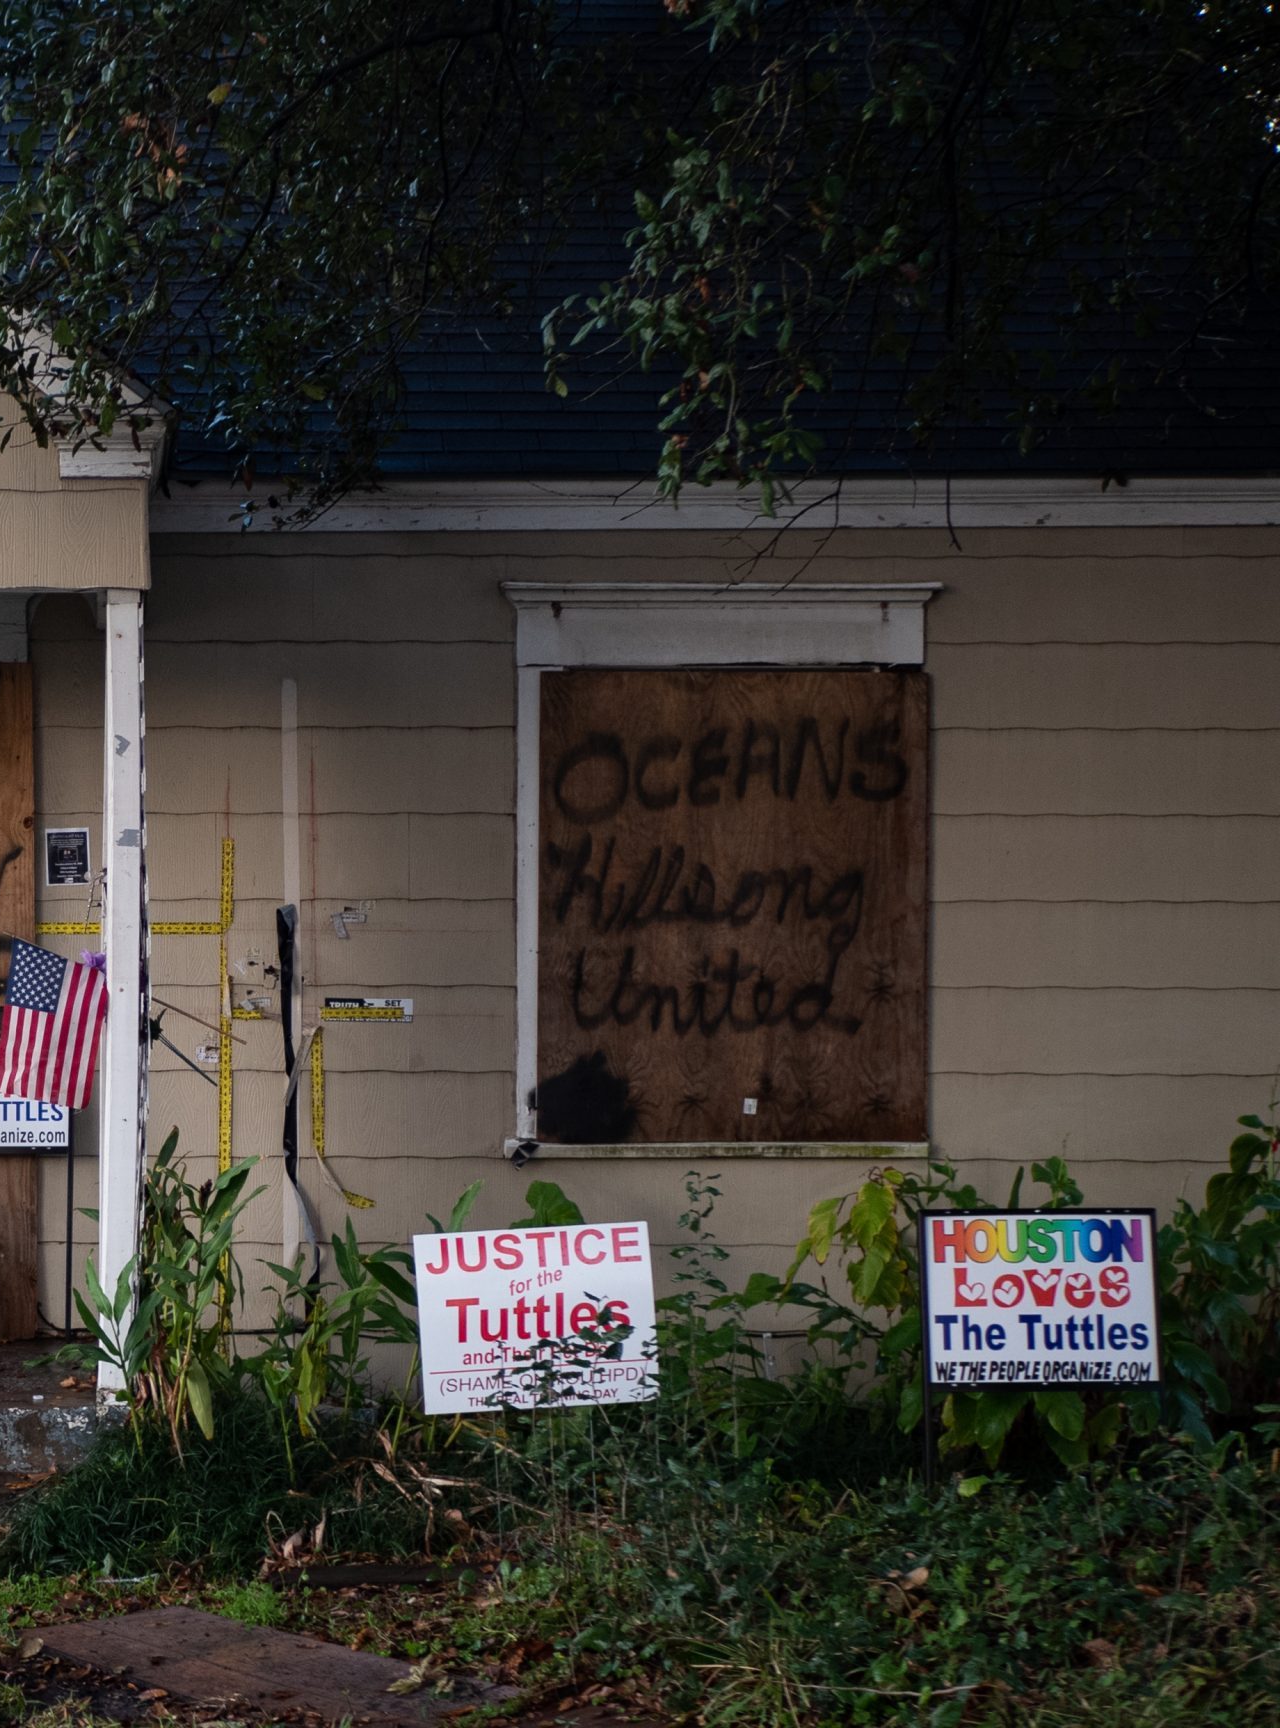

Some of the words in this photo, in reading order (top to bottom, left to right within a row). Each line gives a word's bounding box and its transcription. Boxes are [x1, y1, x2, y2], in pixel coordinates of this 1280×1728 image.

[547, 833, 863, 953] Hillsong
[573, 945, 860, 1036] United
[425, 1226, 643, 1275] JUSTICE
[932, 1218, 1144, 1264] HOUSTON
[509, 1277, 533, 1297] for
[537, 1269, 563, 1288] the
[445, 1292, 631, 1343] Tuttles
[934, 1314, 1006, 1351] The
[1018, 1314, 1150, 1351] Tuttles
[463, 1348, 495, 1366] and
